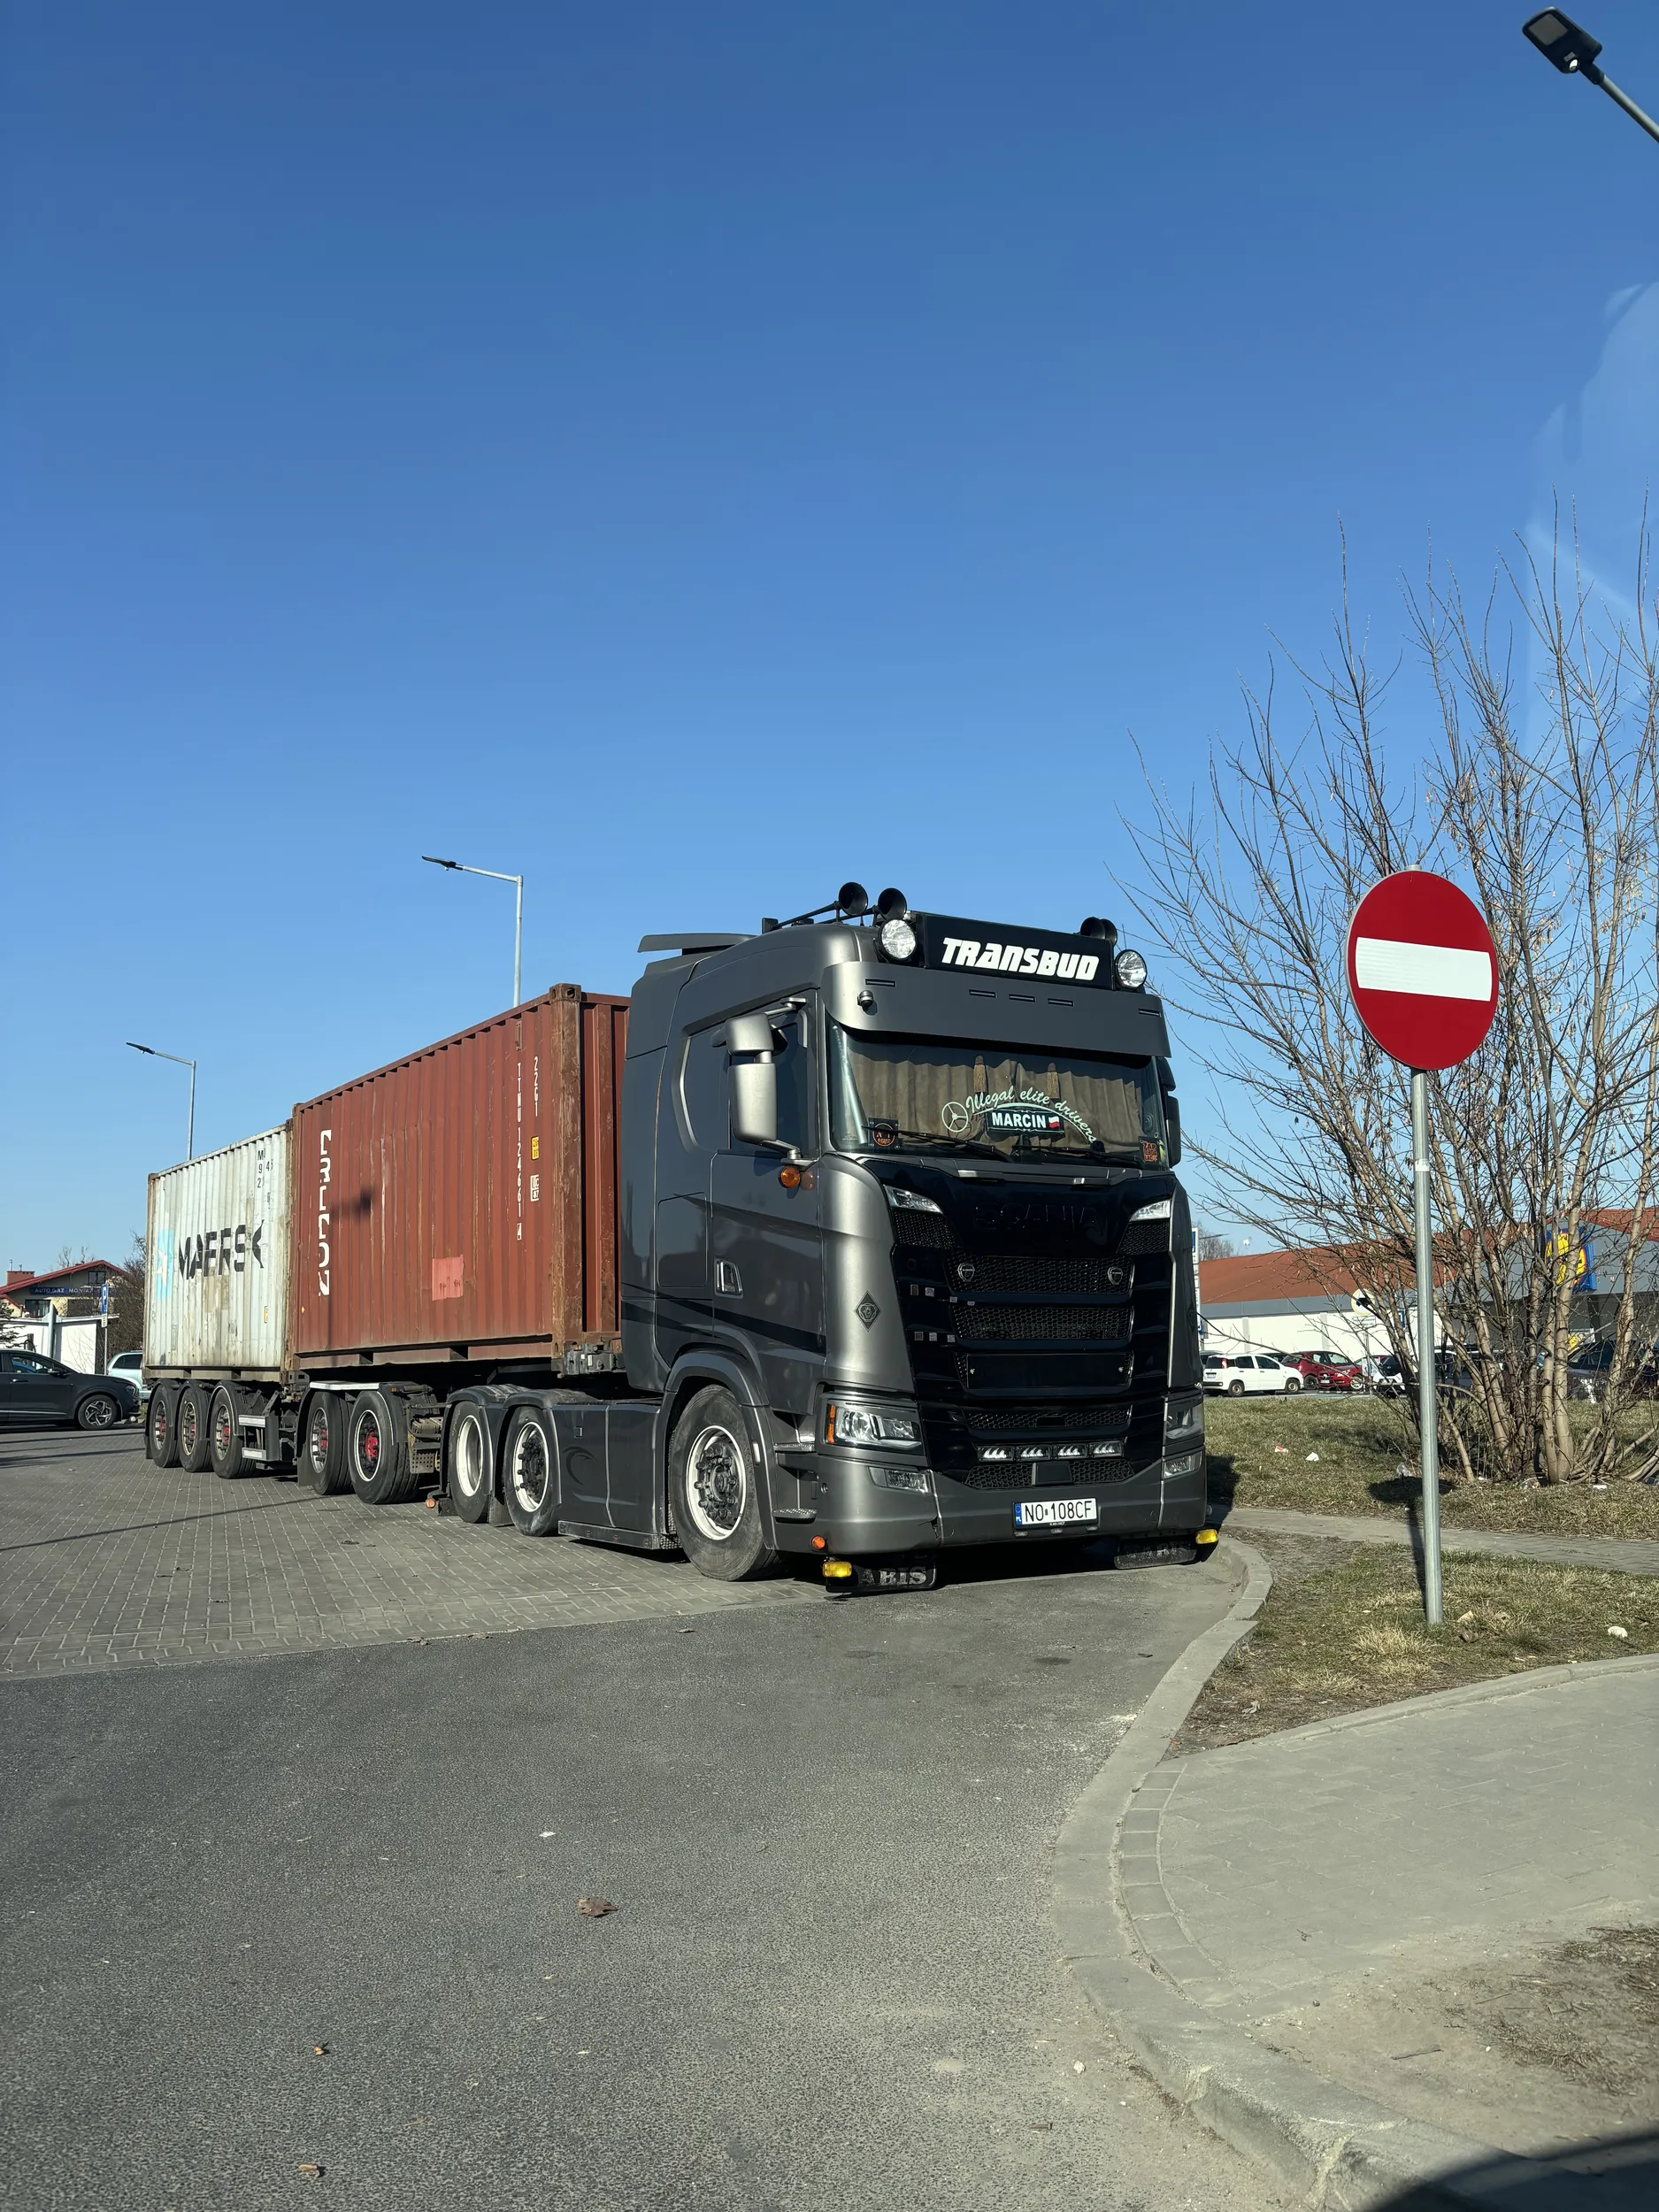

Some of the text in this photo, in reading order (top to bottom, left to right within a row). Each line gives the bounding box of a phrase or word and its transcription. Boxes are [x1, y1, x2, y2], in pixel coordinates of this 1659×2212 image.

[941, 937, 1100, 981] TRANSBUD
[966, 1085, 1097, 1144] Illegal elite drivers
[991, 1112, 1047, 1129] MARCIN
[1025, 1500, 1093, 1523] NO 108CF
